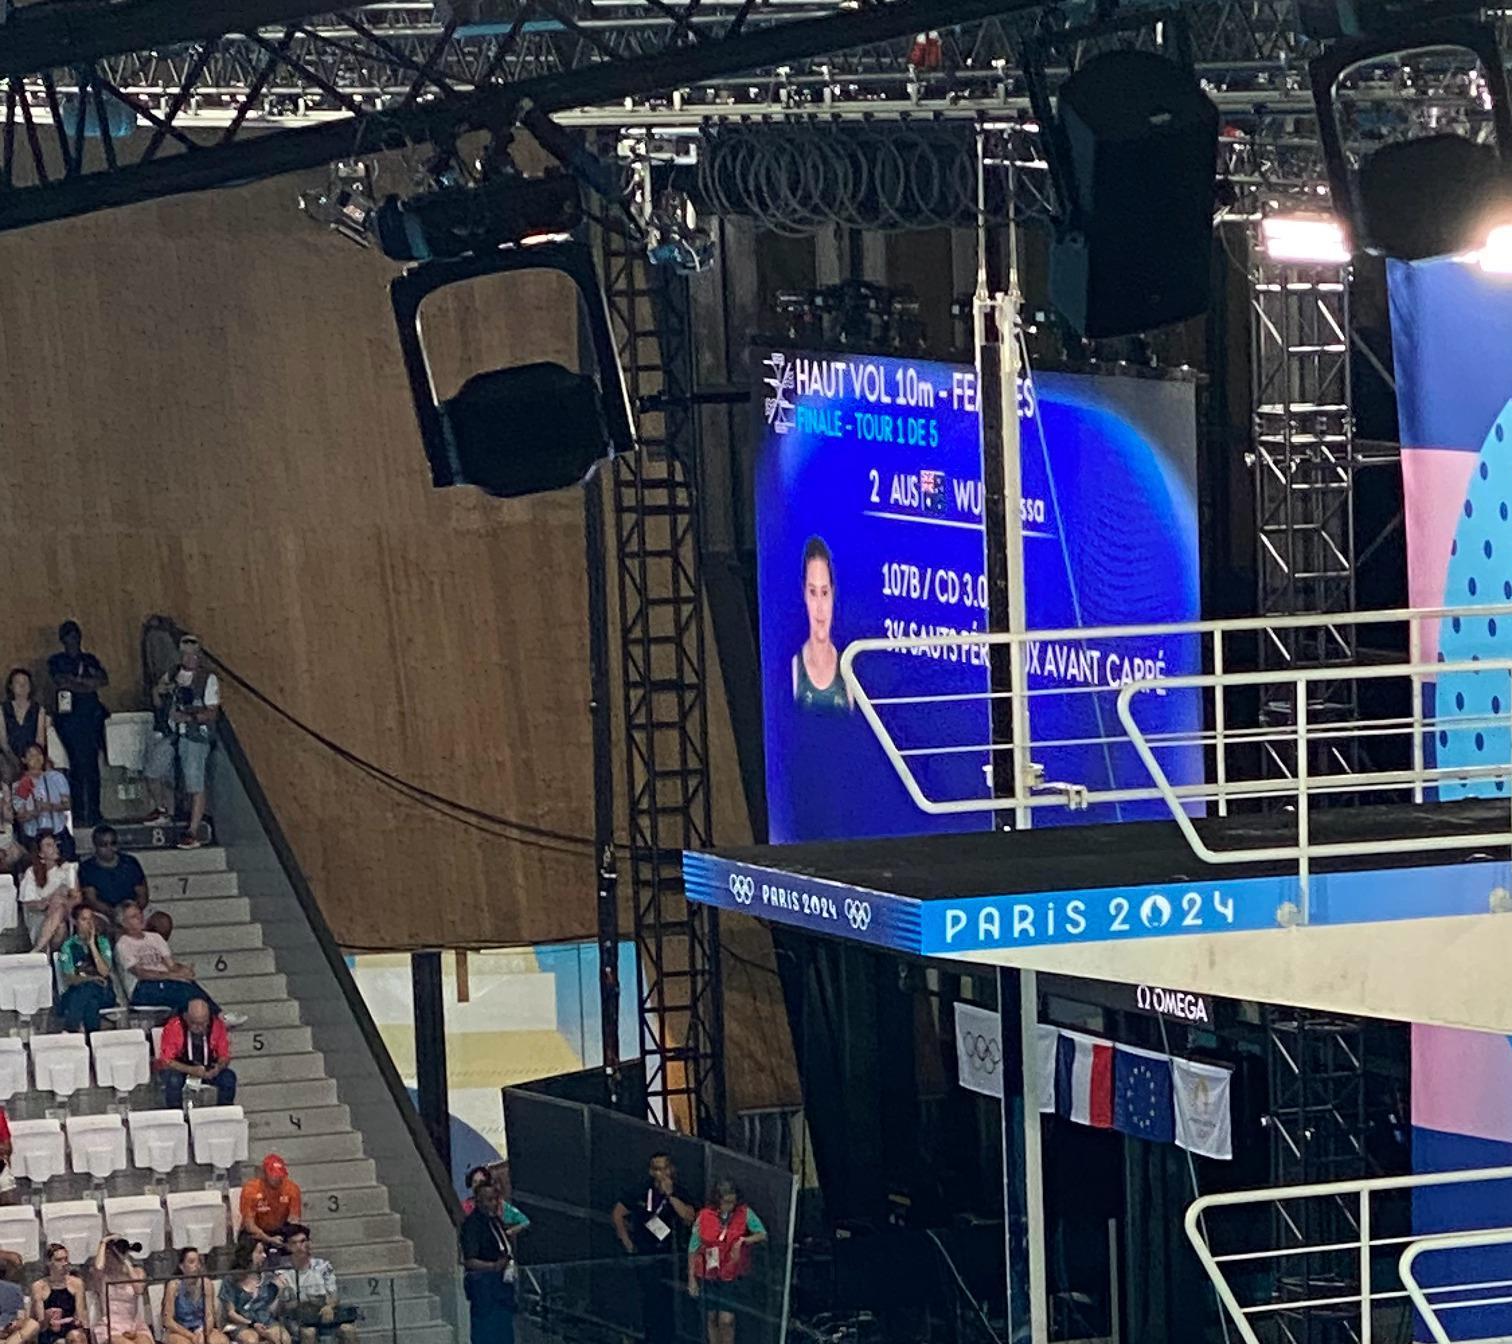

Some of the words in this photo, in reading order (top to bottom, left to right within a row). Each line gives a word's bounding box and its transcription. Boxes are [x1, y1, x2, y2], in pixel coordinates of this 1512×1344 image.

[795, 358, 845, 398] HAUT
[850, 362, 891, 404] VOL
[895, 368, 934, 408] 10m
[796, 405, 842, 437] FINALE
[854, 412, 892, 442] TOUR
[897, 419, 905, 445] 1
[908, 419, 926, 446] DE
[929, 420, 938, 448] 5
[869, 469, 880, 503] 2
[890, 475, 918, 508] AUS
[882, 563, 920, 599] 107B
[935, 569, 960, 604] CD
[909, 622, 958, 662] SAUTS
[1043, 642, 1101, 684] AVANT
[153, 831, 165, 846] 8
[178, 878, 189, 894] 7
[802, 893, 838, 920] 2024
[1109, 890, 1234, 932] 2024
[215, 955, 227, 972] 6
[1153, 988, 1208, 1022] OMEGA
[253, 1034, 264, 1050] 5
[289, 1114, 301, 1130] 4
[328, 1195, 339, 1212] 3
[368, 1277, 379, 1296] 2
